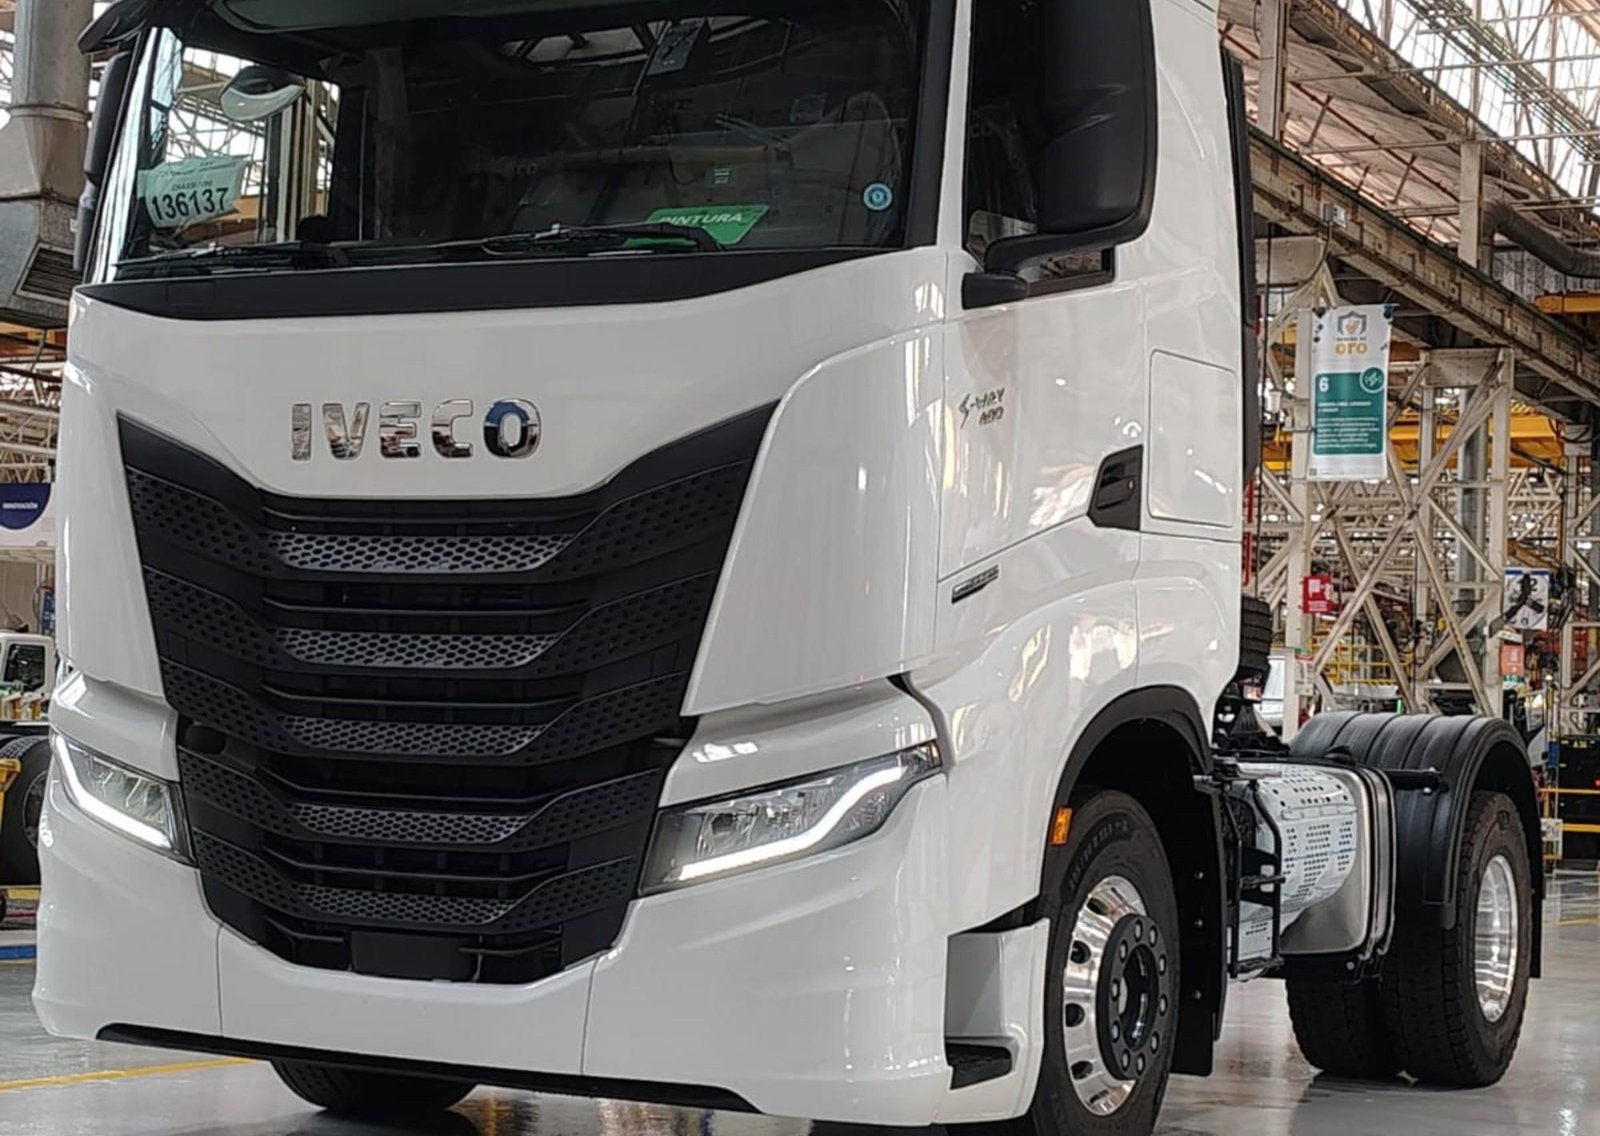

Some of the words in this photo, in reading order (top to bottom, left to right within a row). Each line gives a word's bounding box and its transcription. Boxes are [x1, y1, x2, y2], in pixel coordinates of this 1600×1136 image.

[151, 187, 229, 220] 136137
[1319, 376, 1329, 392] 6
[291, 399, 541, 460] IVECO
